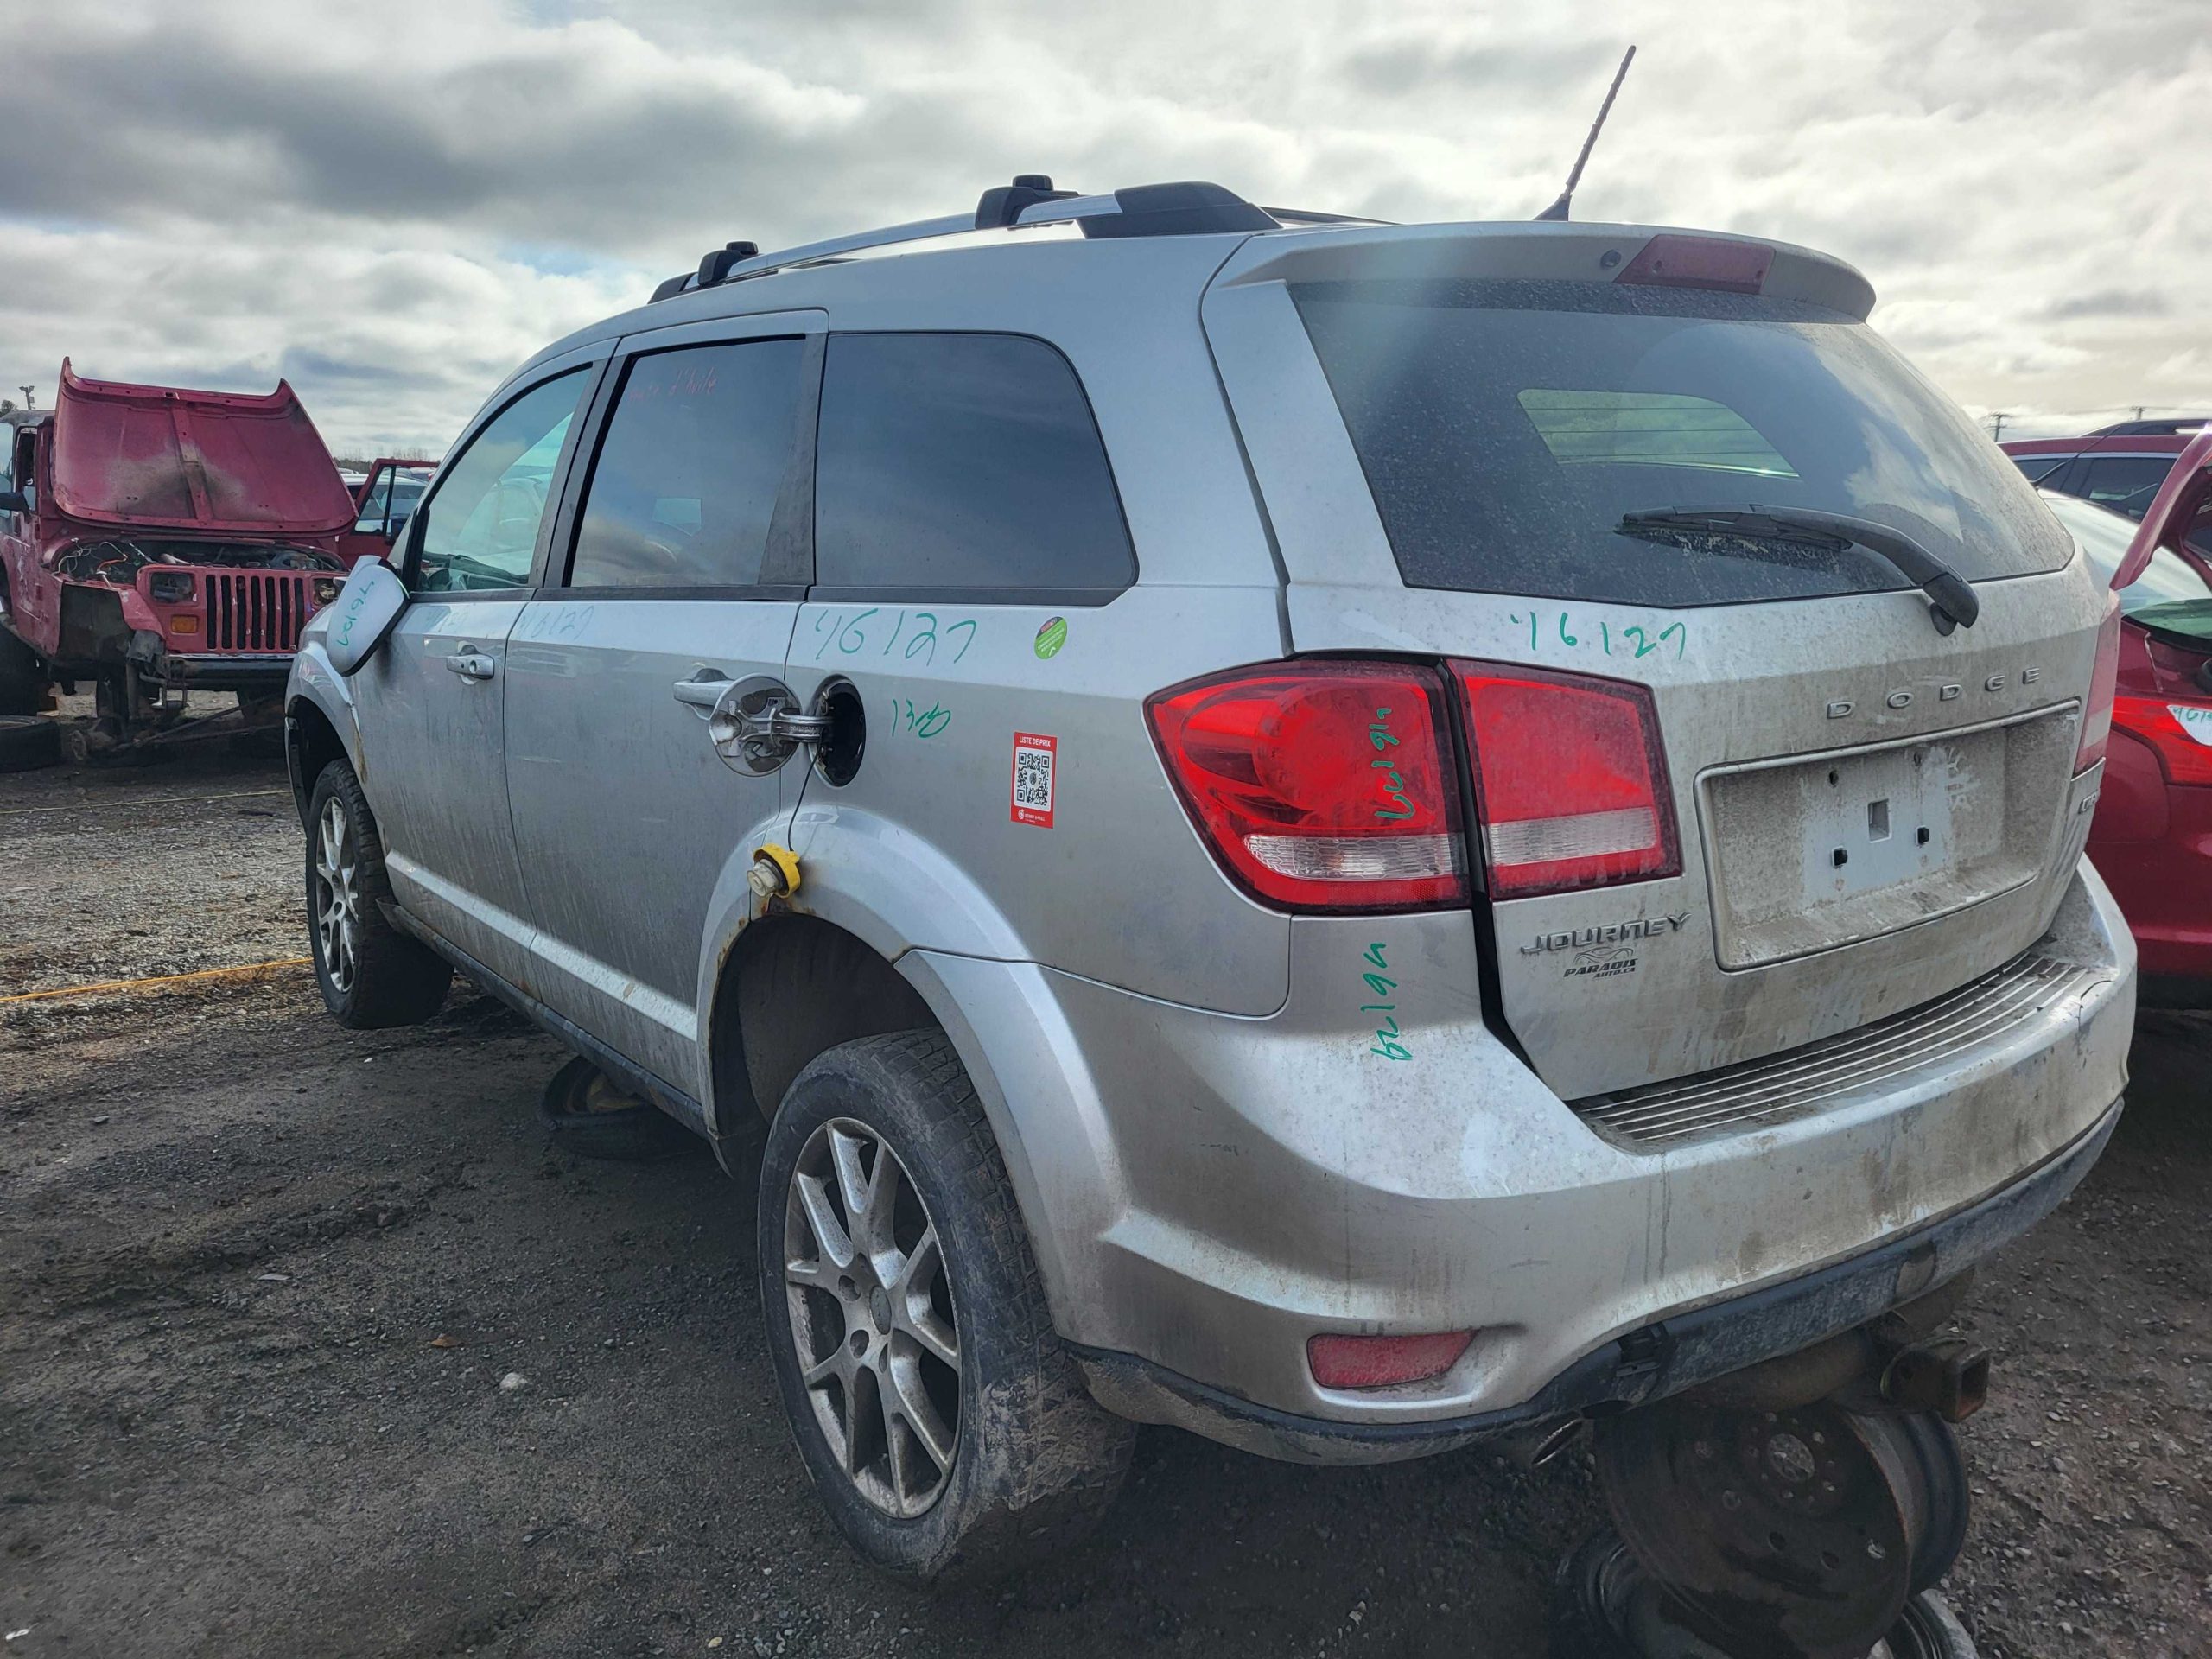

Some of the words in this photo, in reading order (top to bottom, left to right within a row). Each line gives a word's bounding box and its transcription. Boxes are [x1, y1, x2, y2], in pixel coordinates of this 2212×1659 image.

[815, 607, 976, 666] 46127
[1827, 667, 2040, 719] DODGE
[1019, 736, 1033, 745] LISTE
[1520, 912, 1693, 954] JOURNEY
[1563, 957, 1639, 978] PARADIS
